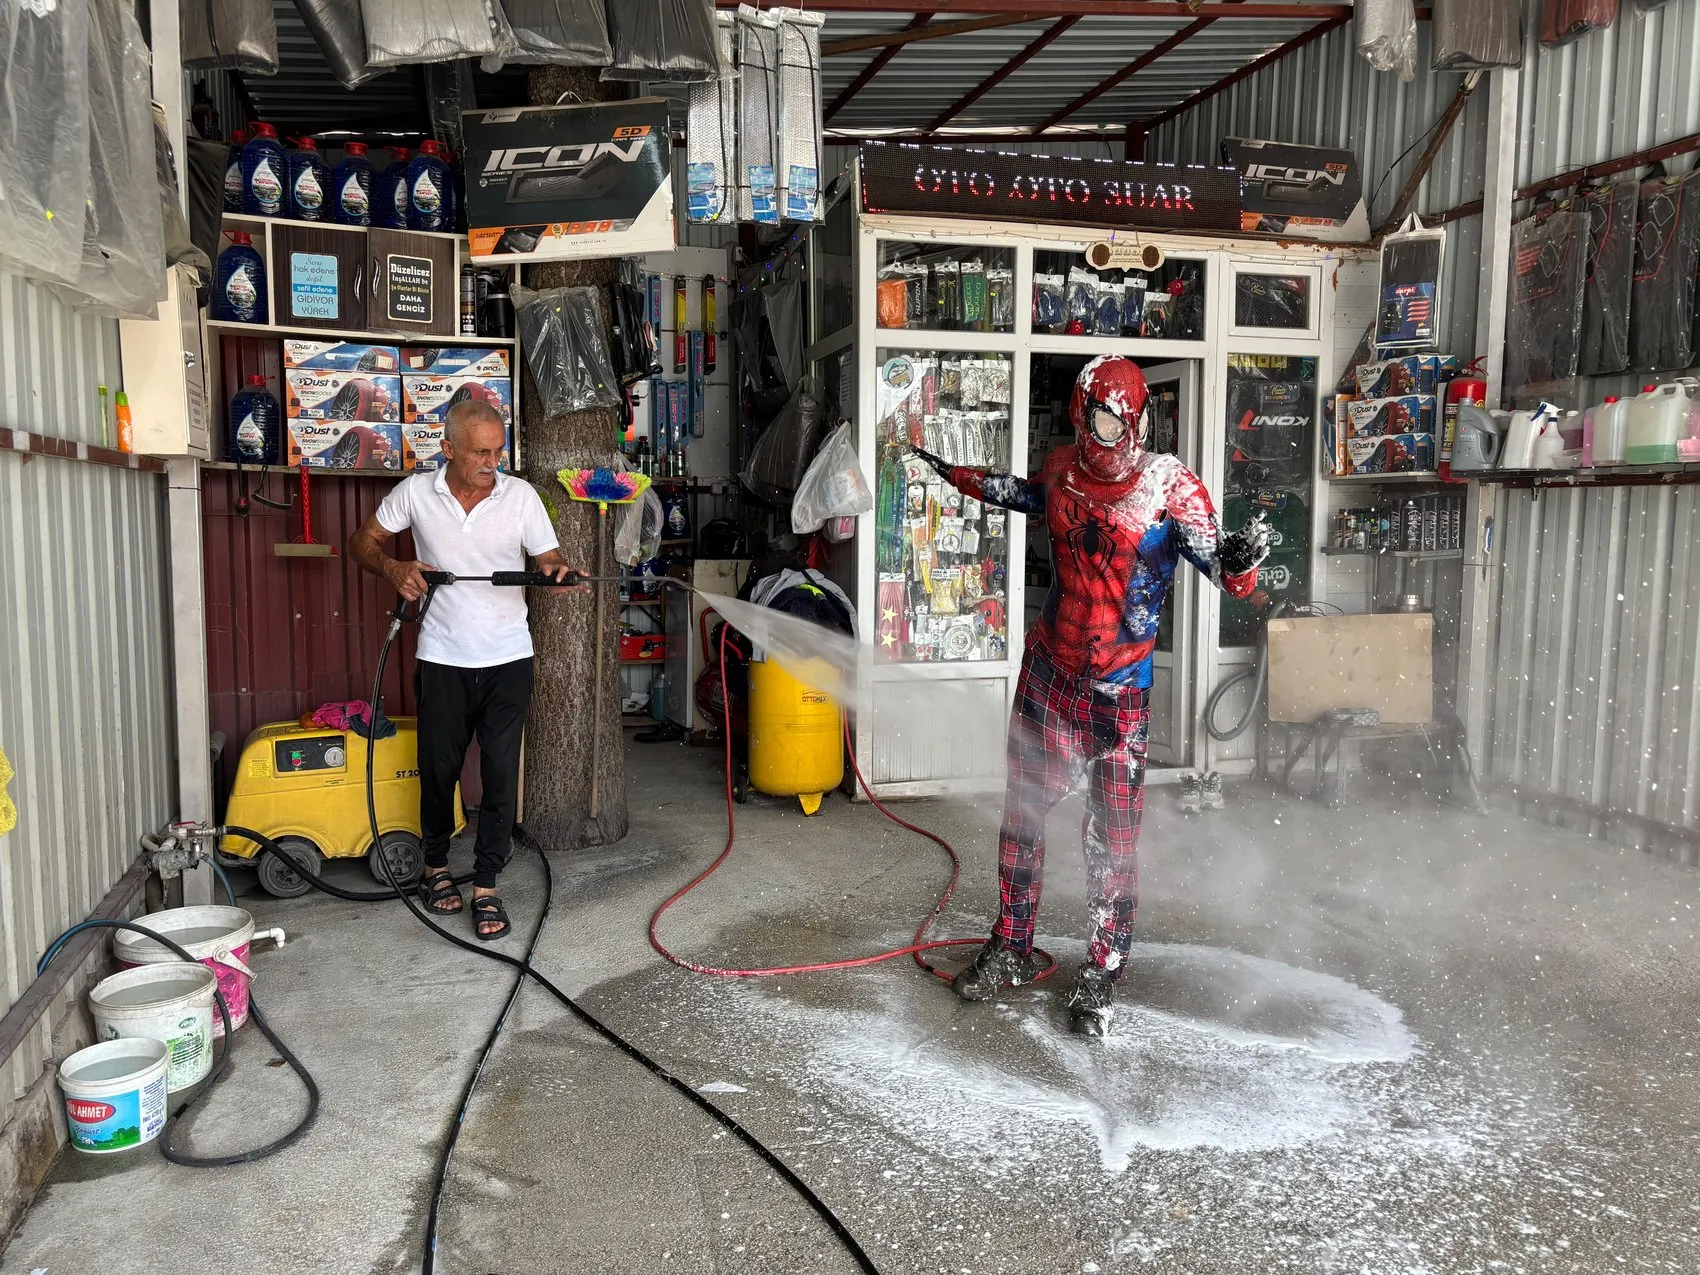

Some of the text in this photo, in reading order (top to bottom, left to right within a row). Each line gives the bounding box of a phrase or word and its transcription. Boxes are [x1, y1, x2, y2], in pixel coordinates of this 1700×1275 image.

[620, 128, 642, 136] 5D
[483, 140, 645, 172] ICON
[1245, 164, 1346, 186] ICON
[294, 265, 309, 273] hak
[390, 263, 430, 277] Düzelicez
[296, 293, 334, 305] GİDİYOR
[400, 294, 422, 303] DAHA
[302, 305, 330, 316] YÜREK
[396, 304, 426, 313] GENCİZ
[1361, 368, 1376, 376] Dust
[304, 378, 329, 387] Dust
[420, 383, 444, 392] Dust
[1357, 406, 1372, 414] Dust
[1252, 416, 1310, 427] KONI
[304, 426, 331, 435] Dust
[418, 430, 443, 439] Dust
[1355, 441, 1370, 450] Dust
[396, 770, 406, 778] ST
[77, 1106, 108, 1118] AHMET
